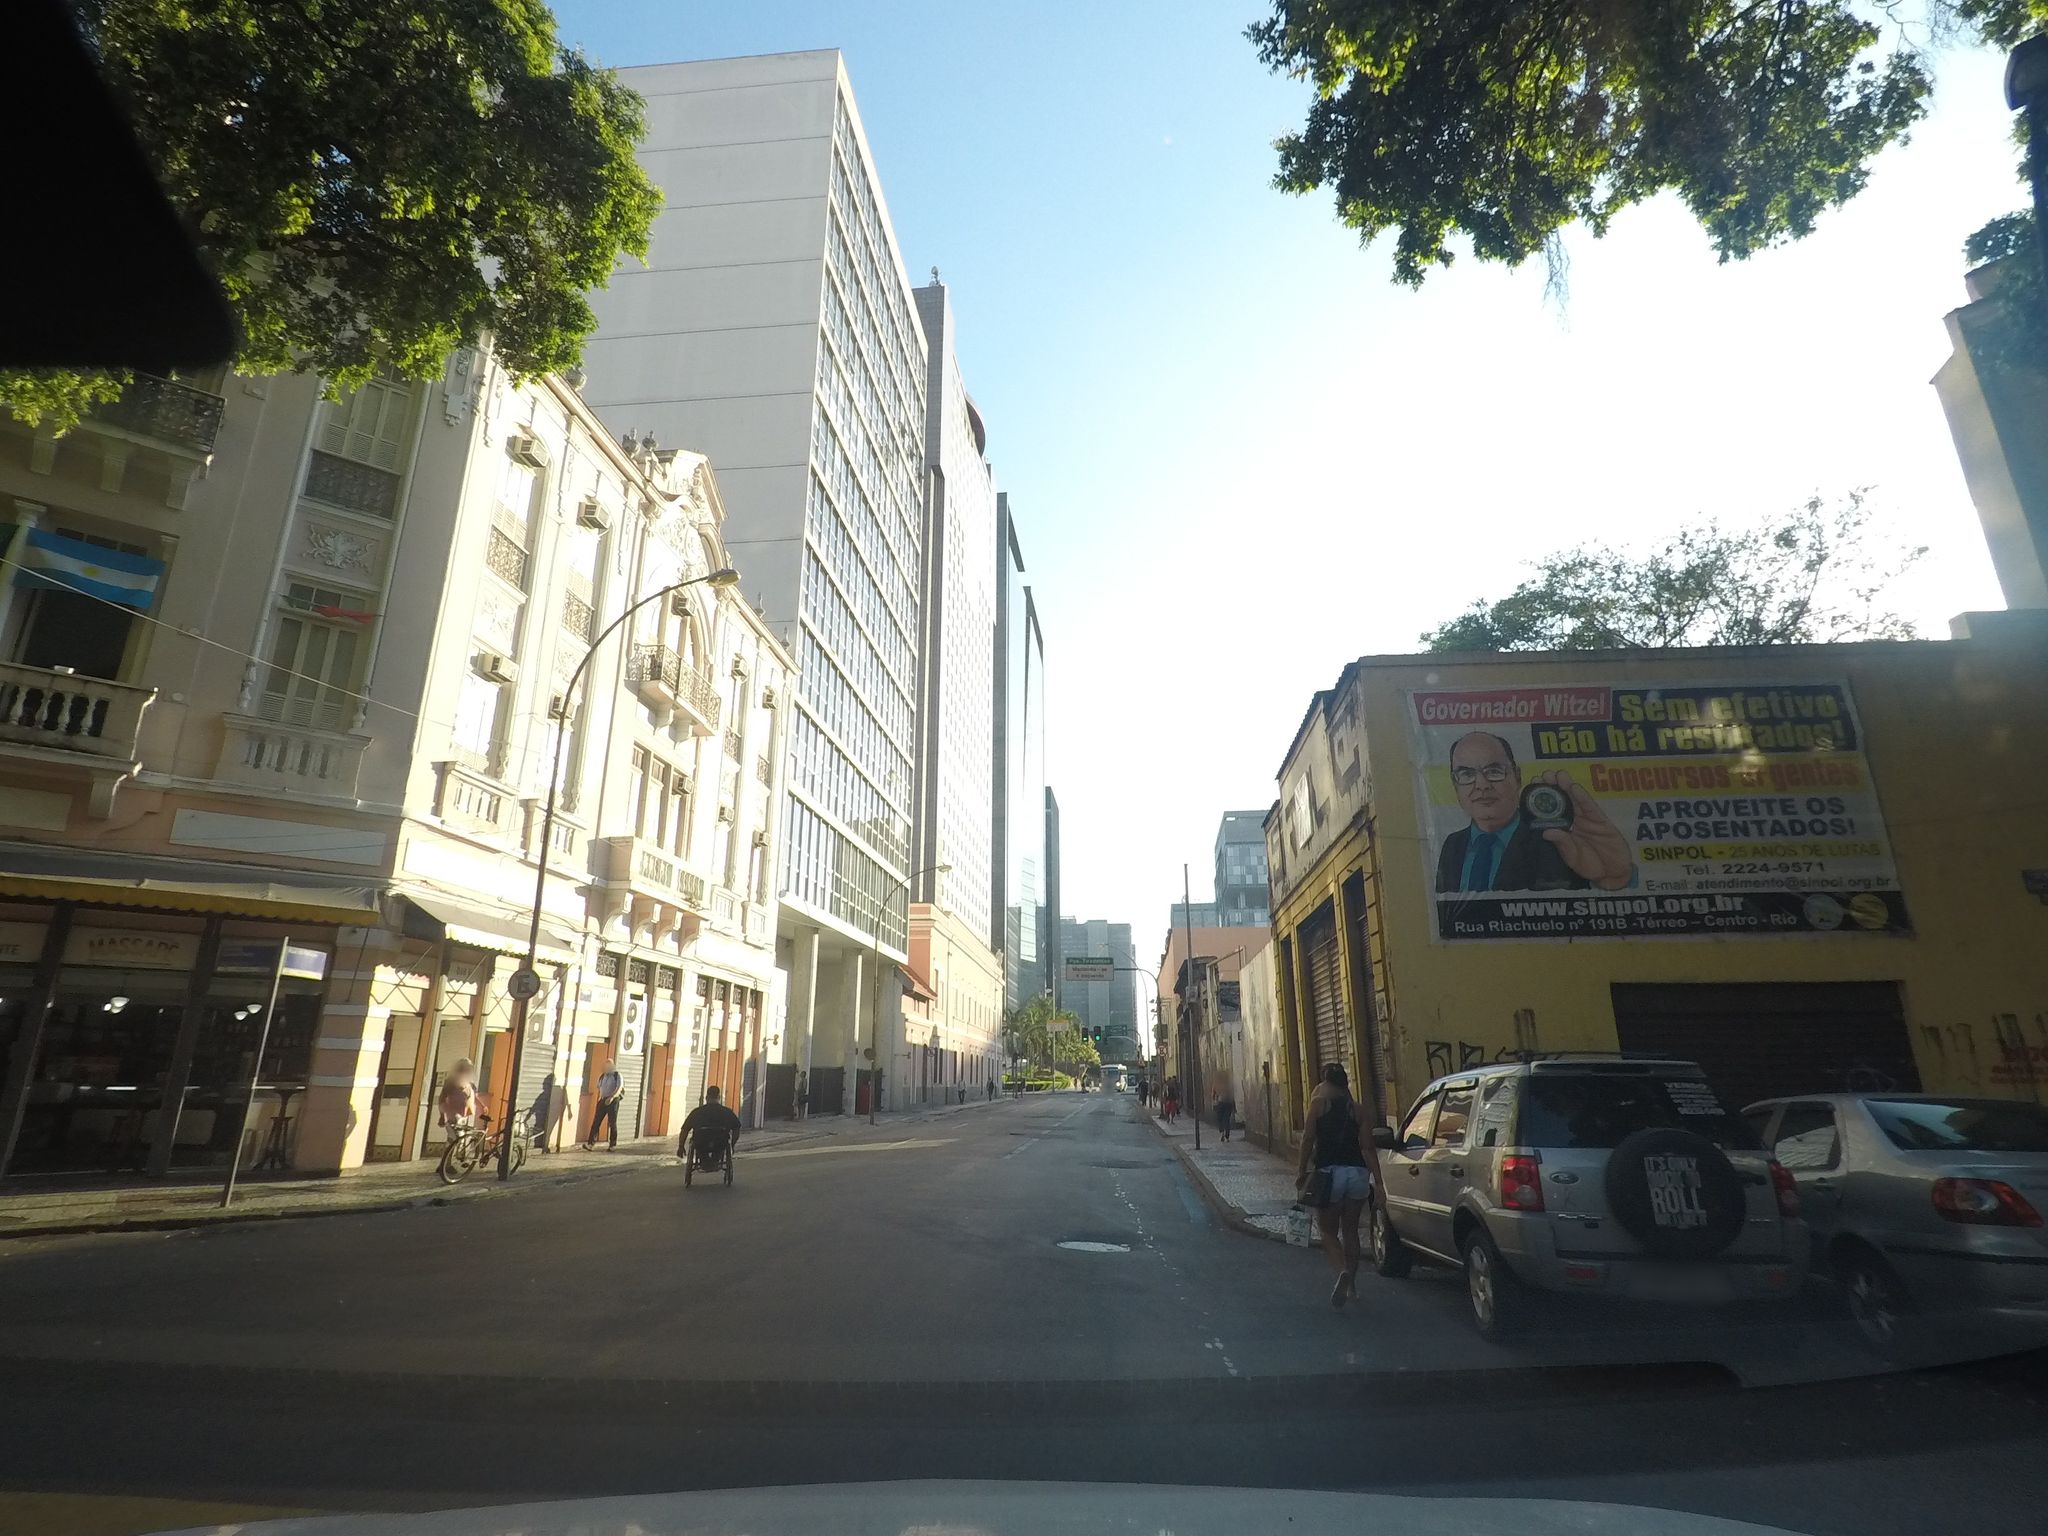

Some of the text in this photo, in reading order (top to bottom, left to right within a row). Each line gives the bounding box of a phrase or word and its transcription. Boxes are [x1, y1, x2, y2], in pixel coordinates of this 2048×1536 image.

[1422, 692, 1605, 721] Governador Witzel
[1618, 690, 1839, 722] Sem efetivo
[1538, 719, 1846, 754] não há resultados!
[1590, 764, 1730, 792] Concursos
[1637, 797, 1845, 820] APROVEITE OS
[1636, 818, 1856, 841] APOSENTADOS!
[1643, 845, 1712, 861] SINPOL
[1729, 845, 1748, 859] 25
[1752, 844, 1797, 858] ANOS
[1802, 843, 1821, 857] DE
[1828, 843, 1881, 857] LUTAS
[1682, 862, 1825, 876] Tel. 2224-9571
[1501, 893, 1744, 918] www.sinpol.org.br
[1455, 921, 1485, 934] Rua
[1488, 919, 1564, 933] Riachuelo
[1589, 917, 1628, 931] 191B
[1704, 914, 1758, 928] Centro
[1770, 913, 1797, 927] Rio
[1650, 1186, 1707, 1214] ROLL
